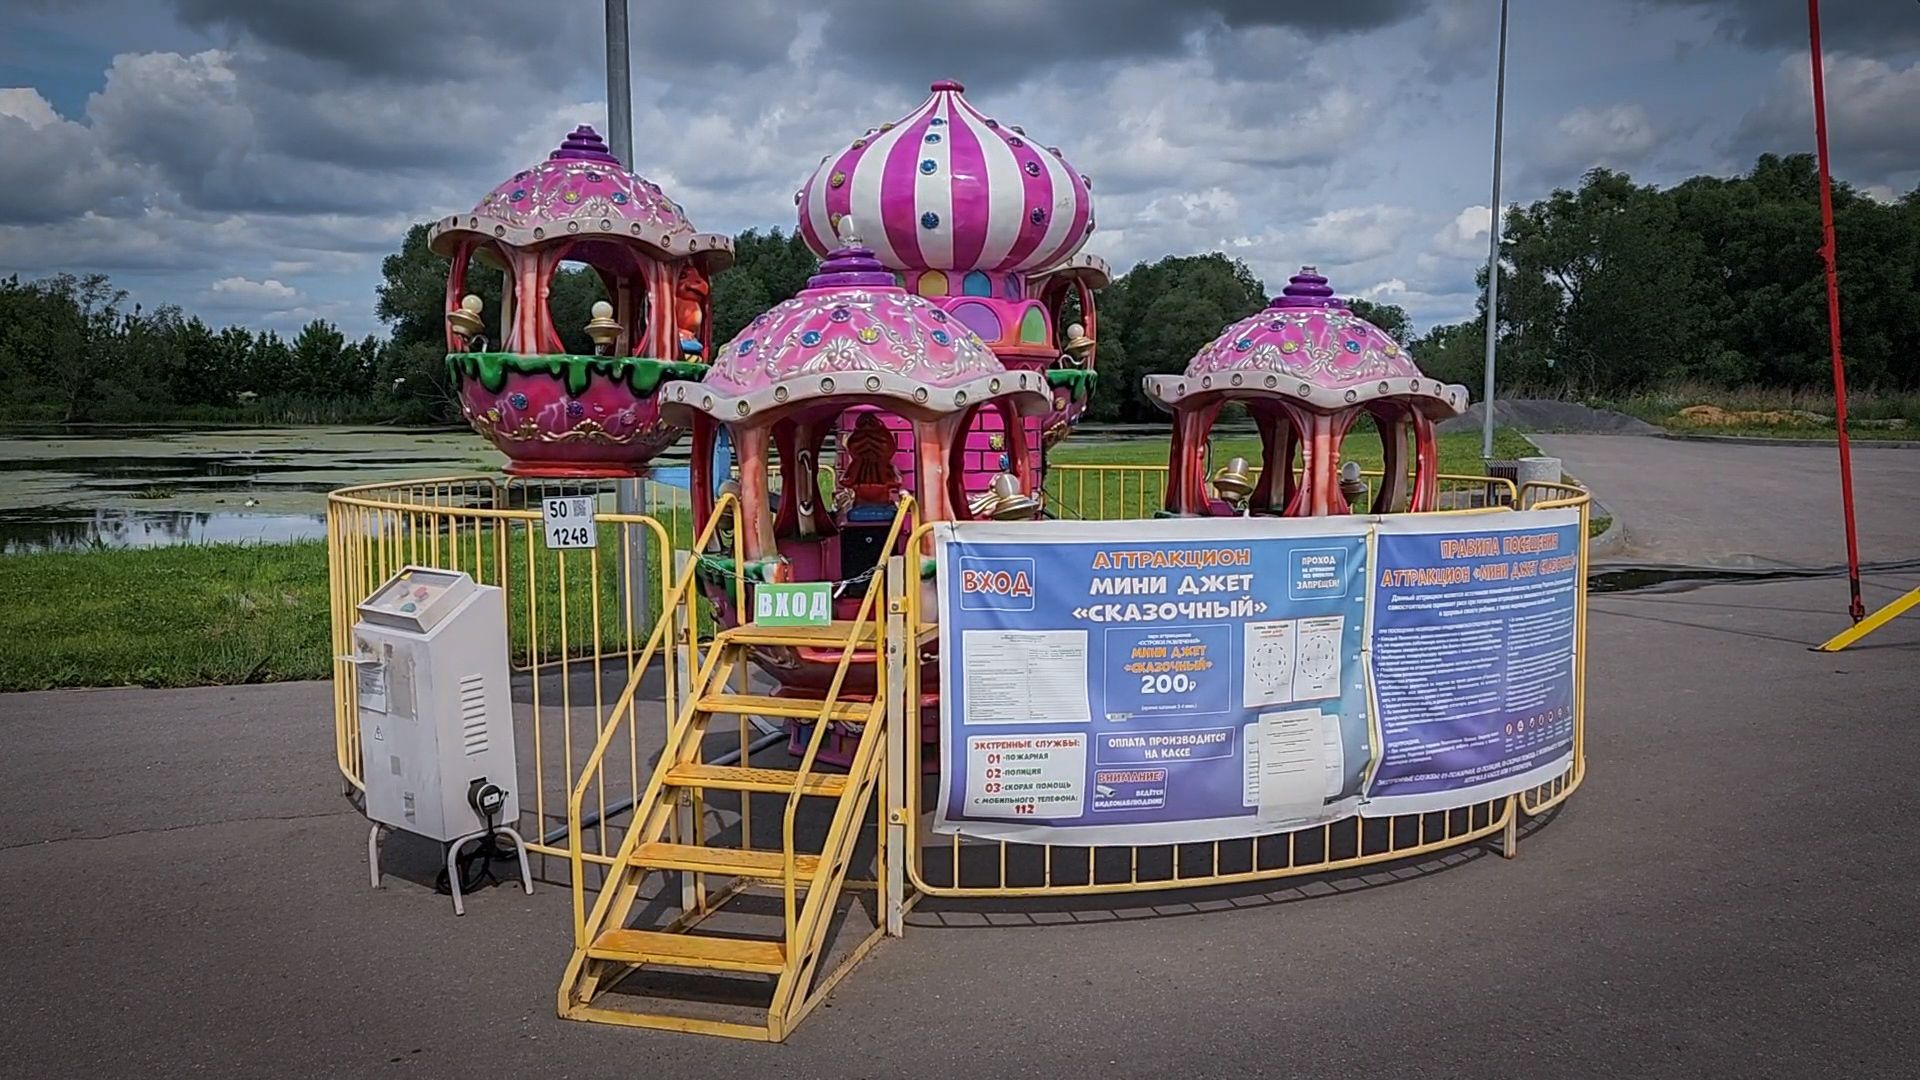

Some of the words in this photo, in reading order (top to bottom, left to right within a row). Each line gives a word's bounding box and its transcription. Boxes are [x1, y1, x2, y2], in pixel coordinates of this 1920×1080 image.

[550, 500, 568, 518] 50
[553, 527, 588, 546] 1248
[1440, 536, 1500, 559] ПРАВИЛА
[1092, 548, 1251, 569] АТТРАКЦИОН
[1301, 556, 1336, 565] ПРОХОД
[962, 569, 1033, 598] ВХОД
[1089, 575, 1167, 595] МИНИ
[1177, 573, 1254, 595] ДЖЕТ
[1380, 566, 1471, 588] АТТРАКЦИОН
[758, 591, 828, 620] ВХОД
[1071, 595, 1268, 622] «СКАЗОЧНЫЙ»
[1131, 646, 1167, 659] МИНИ
[1171, 644, 1207, 659] ДЖЕТ
[974, 740, 1032, 750] ЭКСТРЕННЫЕ
[1035, 739, 1081, 748] СЛУЖБЫ:
[1108, 736, 1146, 748] ОПЛАТА
[1149, 732, 1226, 747] ПРОИЗВОДИТСЯ
[1144, 749, 1158, 759] НА
[1161, 747, 1191, 758] КАССЕ
[1036, 781, 1072, 790] ПОМОЩЬ
[1097, 770, 1165, 784] ВНИМАНИЕ!
[982, 796, 1035, 804] МОБИЛЬНОГО
[1037, 795, 1079, 803] ТЕЛЕФОНА:
[1014, 804, 1035, 814] 112
